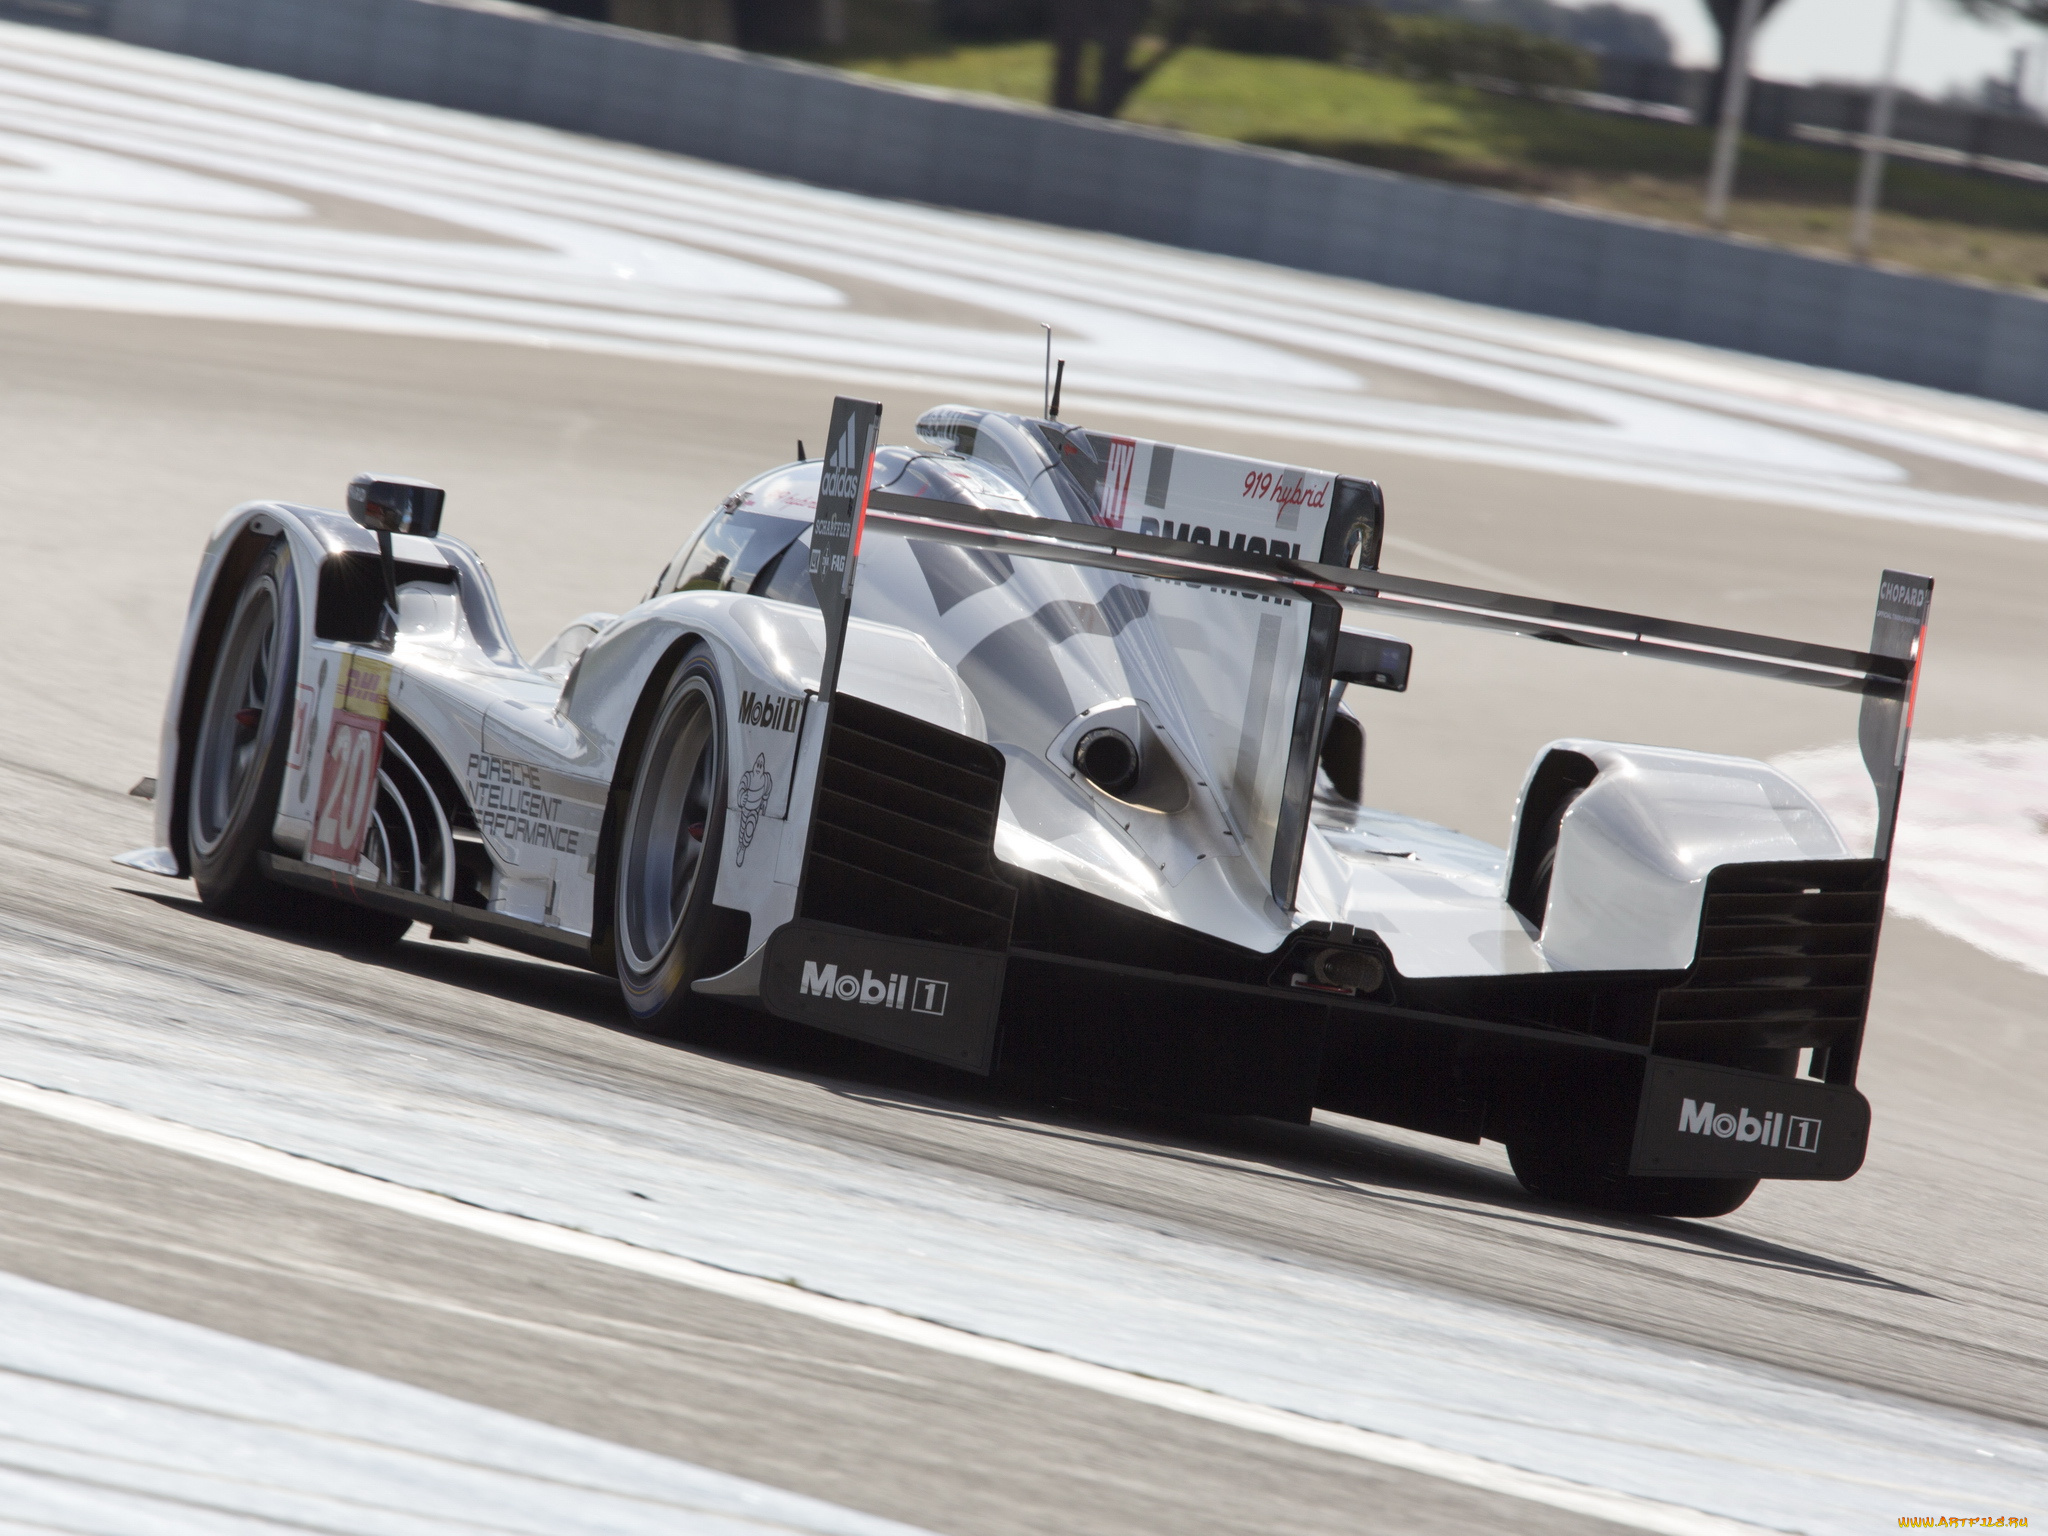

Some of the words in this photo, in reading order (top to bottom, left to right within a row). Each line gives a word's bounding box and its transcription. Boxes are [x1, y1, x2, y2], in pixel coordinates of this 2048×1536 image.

[821, 467, 858, 499] adidas
[1242, 470, 1273, 499] 919
[1269, 474, 1330, 522] hybrid
[830, 554, 846, 573] FAG
[1880, 582, 1924, 607] CHOPARD
[738, 690, 786, 730] Mobil
[785, 699, 799, 732] 1
[316, 725, 372, 850] 20
[467, 753, 541, 791] PORSCHE
[800, 960, 908, 1010] Mobil
[1678, 1098, 1783, 1147] Mobil
